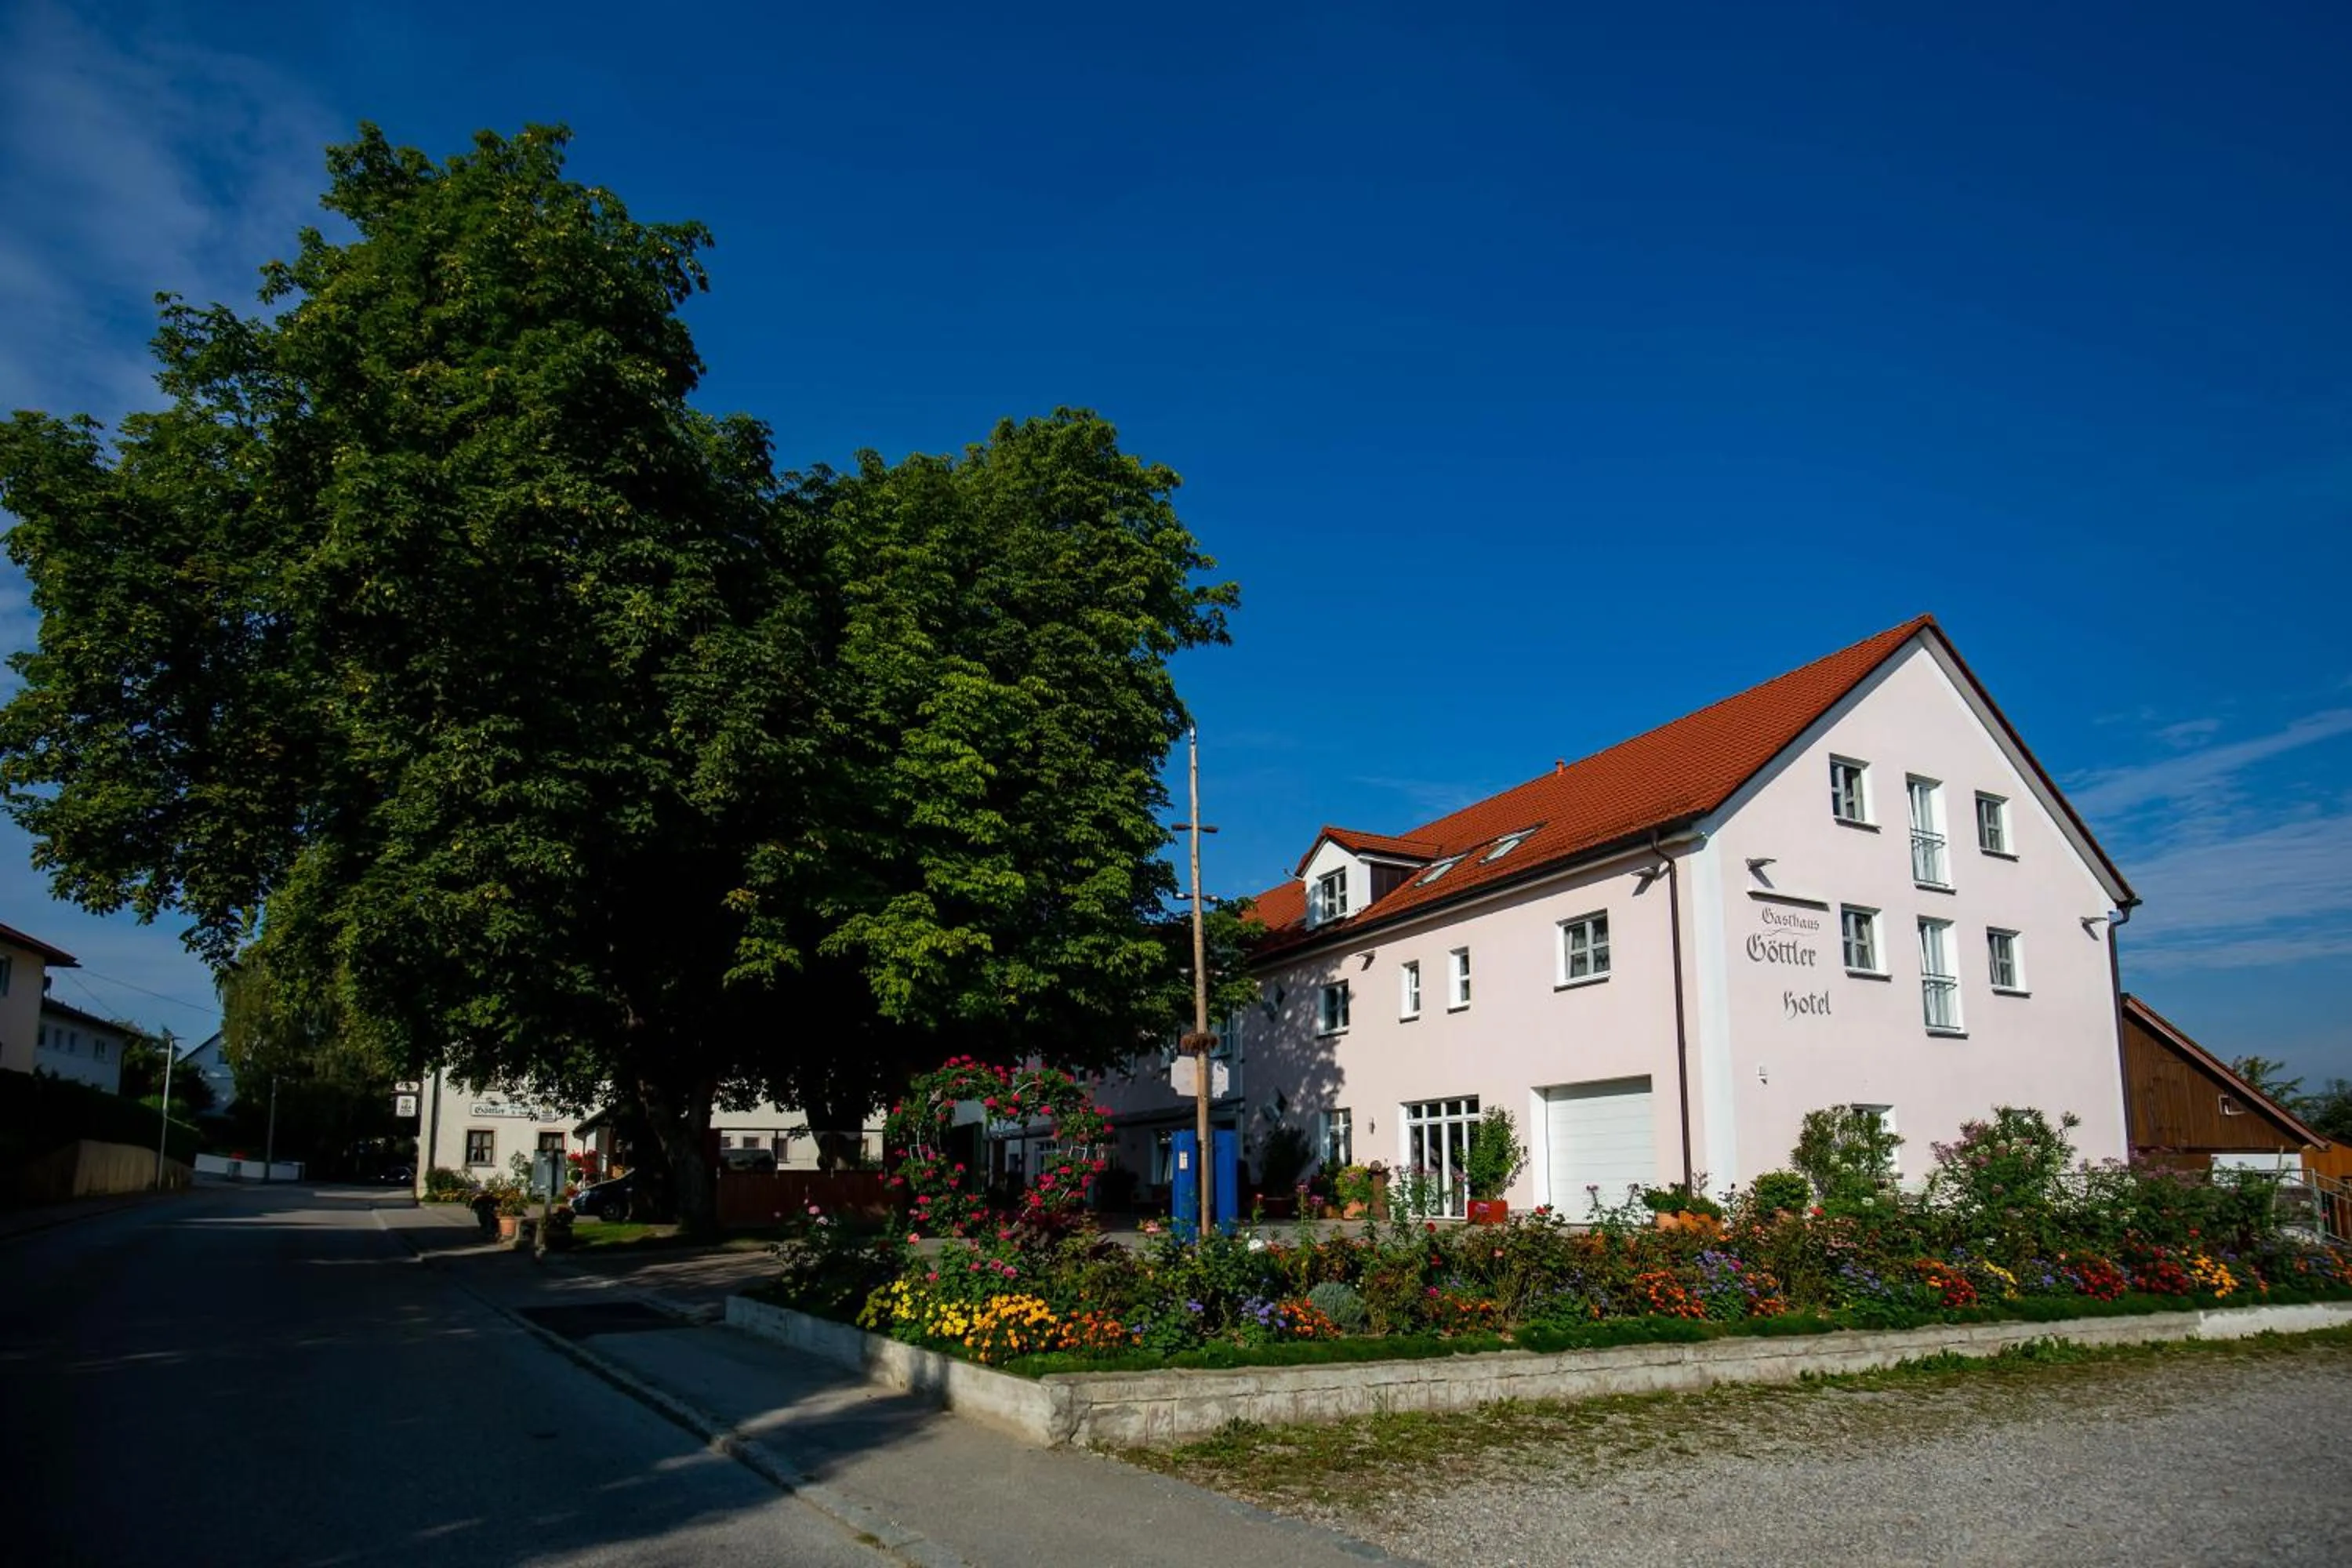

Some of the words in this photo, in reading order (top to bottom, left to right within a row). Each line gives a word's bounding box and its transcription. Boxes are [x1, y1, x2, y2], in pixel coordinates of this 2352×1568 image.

[1761, 907, 1820, 931] Gasthaus
[1746, 932, 1817, 967] Göttler
[1783, 990, 1831, 1020] Hotel
